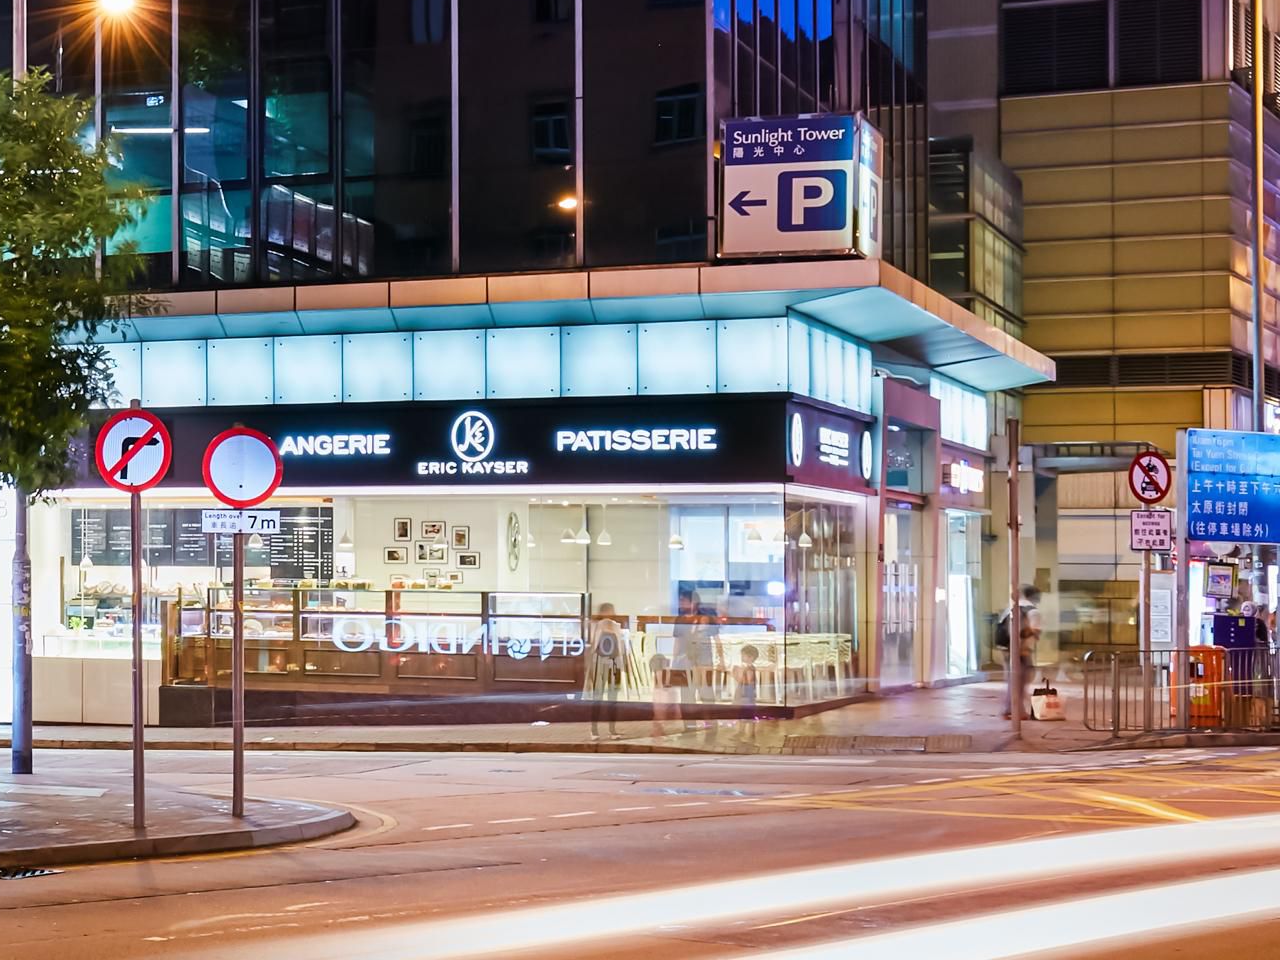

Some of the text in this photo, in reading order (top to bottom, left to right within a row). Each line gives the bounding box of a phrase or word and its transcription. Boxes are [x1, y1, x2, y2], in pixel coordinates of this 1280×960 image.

[733, 128, 792, 147] Sunlight
[797, 127, 846, 142] Tower
[732, 144, 806, 159] 陽光中心
[791, 176, 834, 225] P
[279, 428, 718, 456] ANGERIE PATISSERIE
[417, 460, 529, 475] ERIC KAYSER
